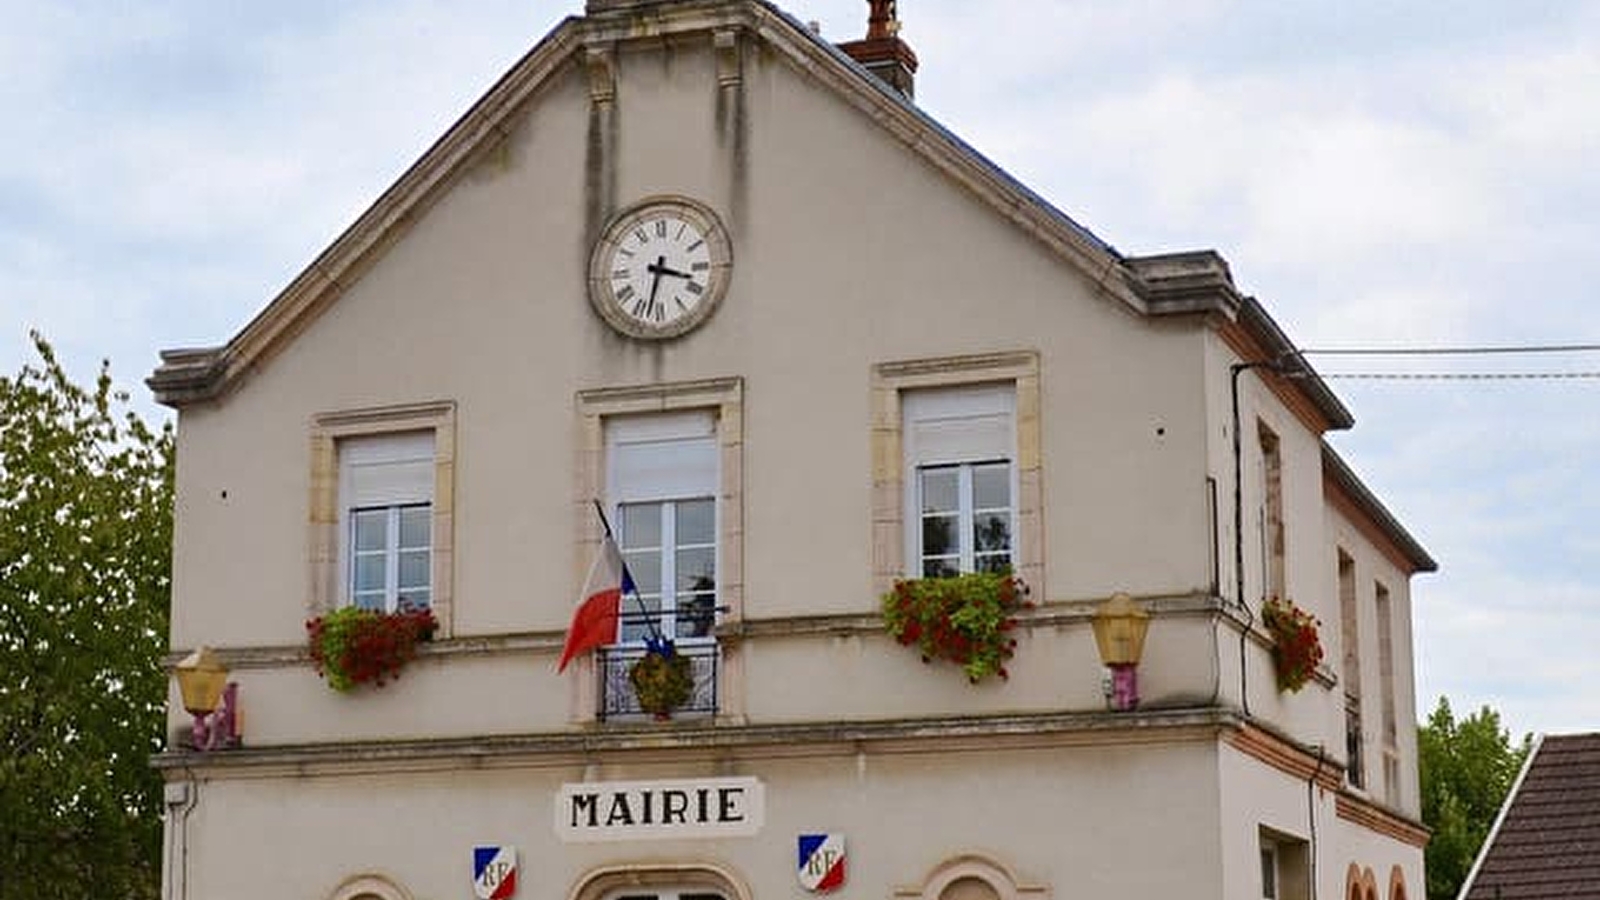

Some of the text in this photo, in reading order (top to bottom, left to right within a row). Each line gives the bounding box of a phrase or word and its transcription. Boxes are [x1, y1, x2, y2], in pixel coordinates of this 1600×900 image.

[571, 788, 744, 827] MAIRIE
[482, 862, 510, 887] RF
[807, 848, 838, 876] RF
